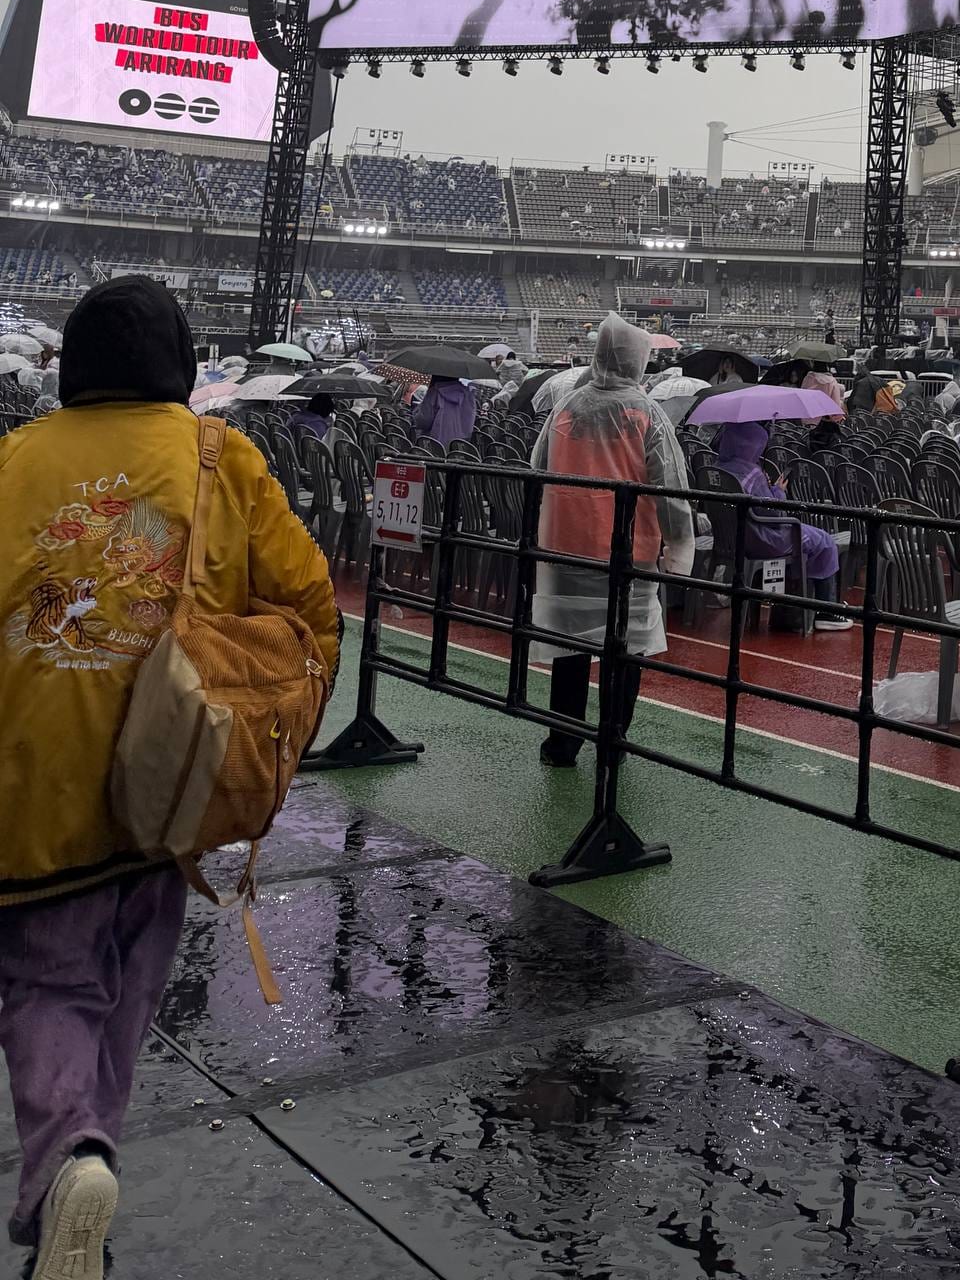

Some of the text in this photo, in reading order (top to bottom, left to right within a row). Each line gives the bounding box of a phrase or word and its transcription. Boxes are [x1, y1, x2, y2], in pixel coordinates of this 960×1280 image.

[160, 8, 202, 32] BTS
[104, 21, 249, 60] WORLD TOUR
[123, 51, 226, 82] ARIRANG
[221, 278, 248, 288] Goyang
[73, 472, 130, 497] TCA
[406, 504, 418, 524] 12
